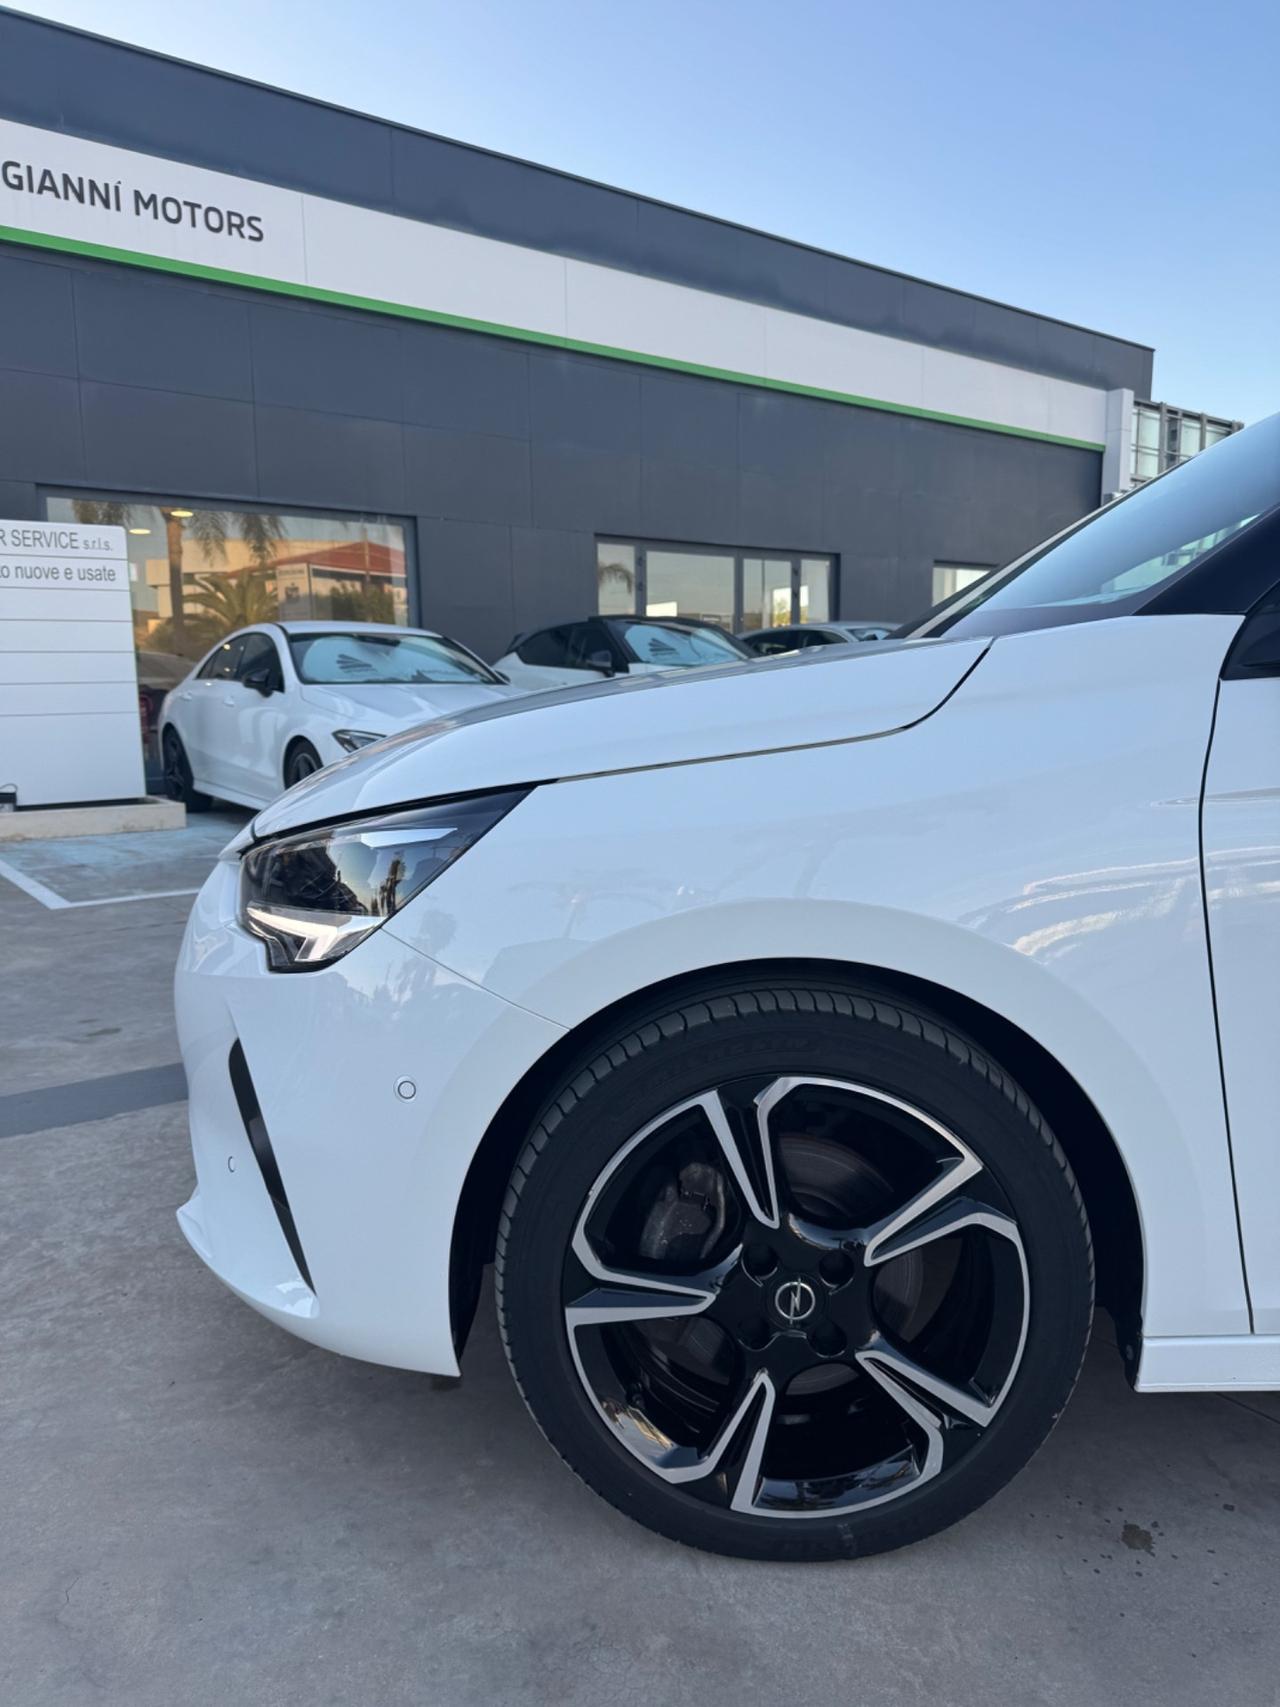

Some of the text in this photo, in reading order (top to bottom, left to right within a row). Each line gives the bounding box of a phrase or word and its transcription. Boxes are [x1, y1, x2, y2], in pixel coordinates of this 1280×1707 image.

[133, 188, 265, 242] MOTORS
[11, 529, 79, 549] SERVICE
[0, 564, 116, 581] o nuove e usate
